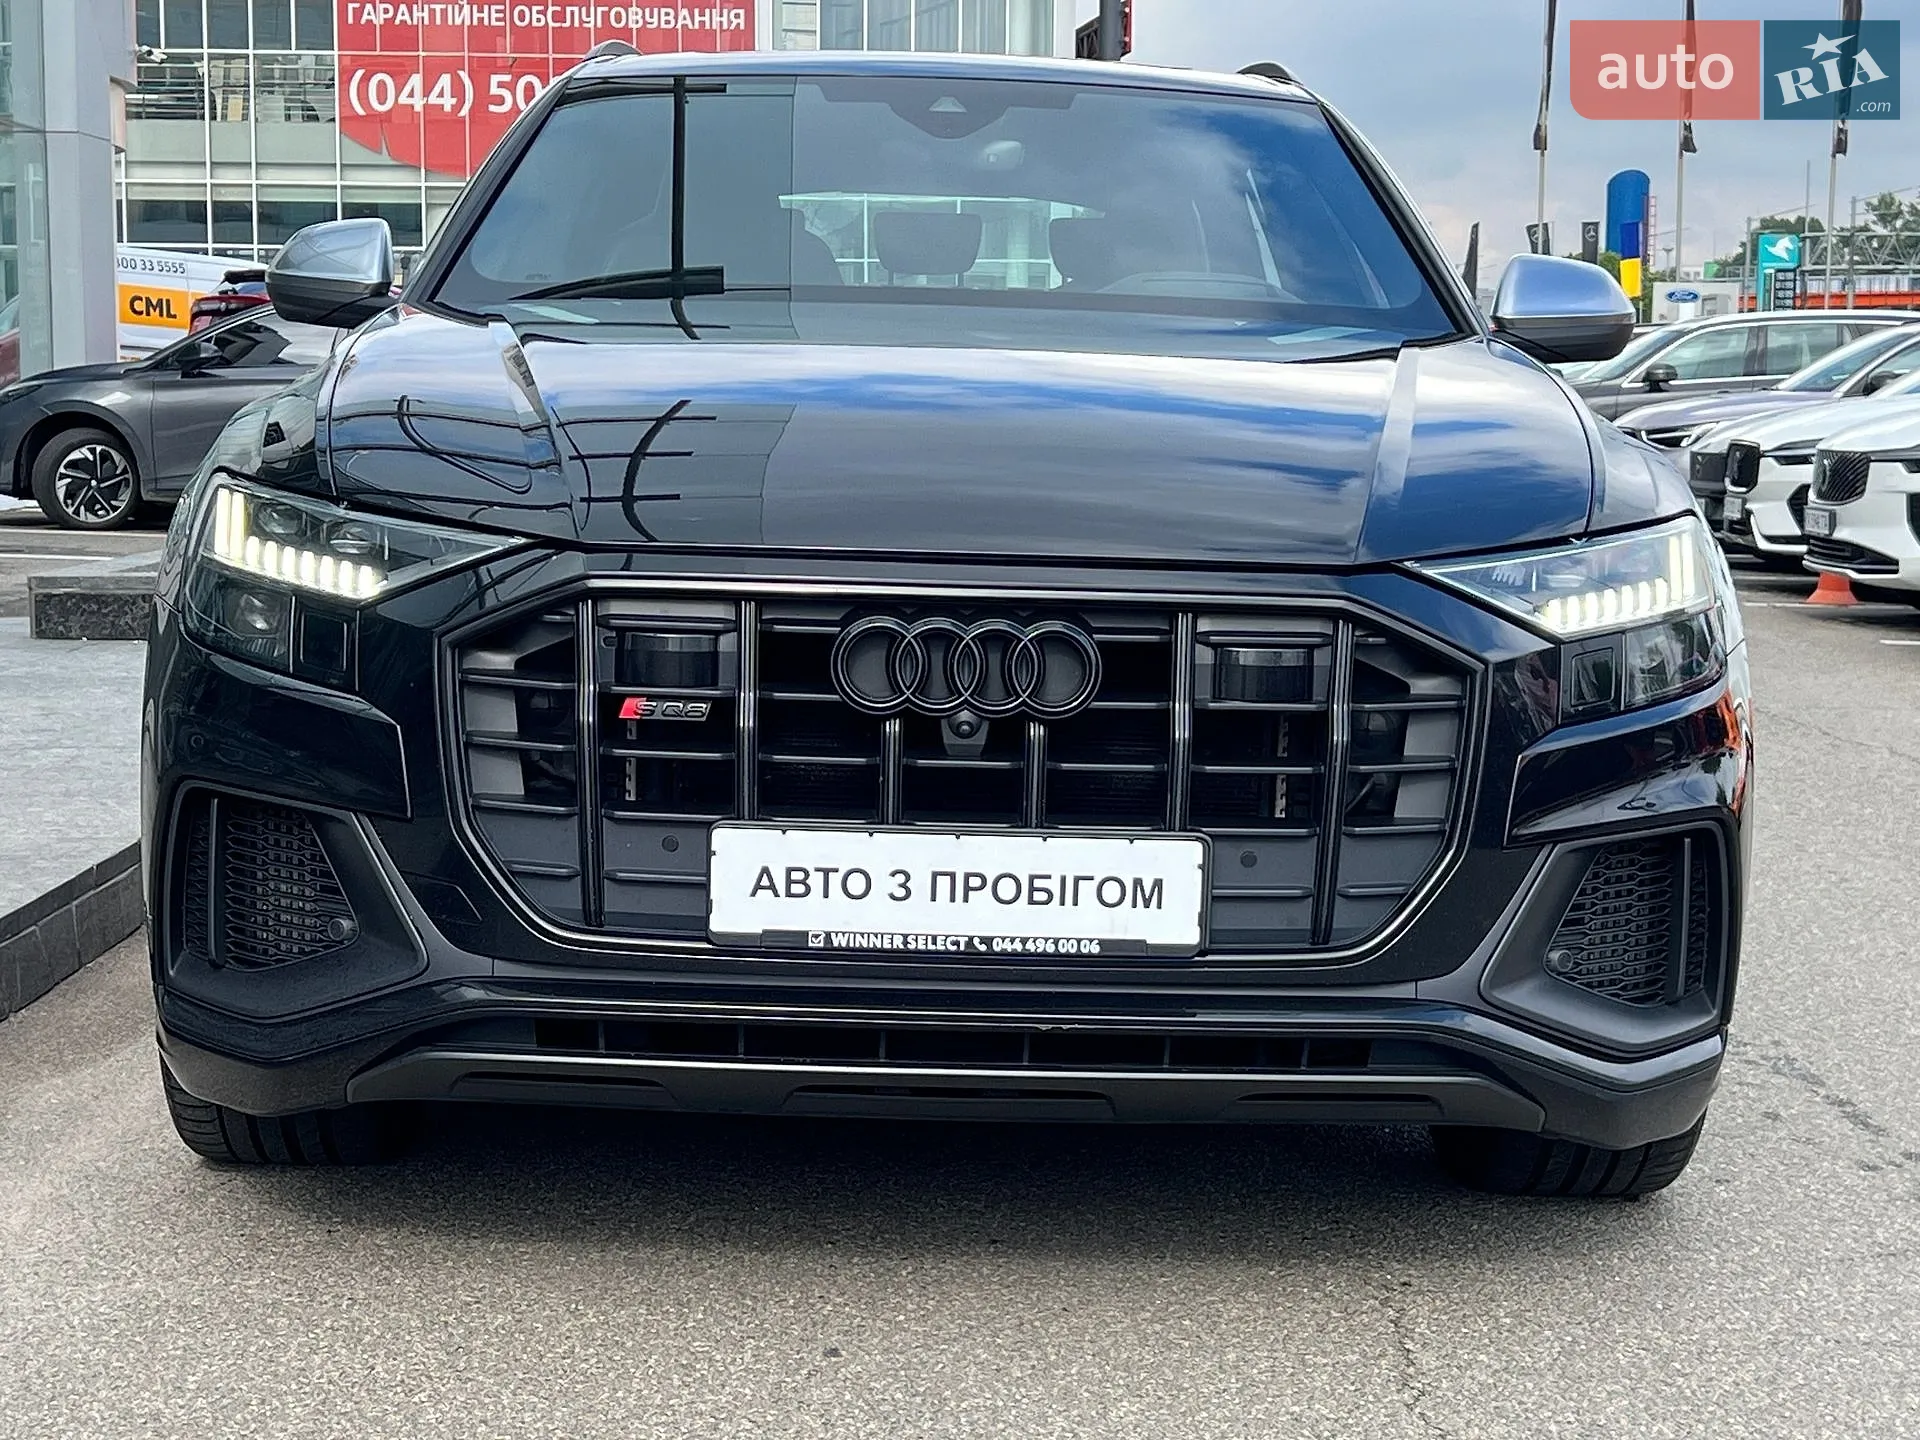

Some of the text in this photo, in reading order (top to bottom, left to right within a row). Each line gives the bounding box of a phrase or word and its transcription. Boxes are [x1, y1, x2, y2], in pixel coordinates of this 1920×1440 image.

[347, 2, 745, 30] ГАРАНТІЙНЕ ОБСЛУГОВУВАННЯ
[349, 69, 562, 117] (044) 50
[140, 259, 154, 272] 33
[157, 260, 186, 274] 5555
[129, 295, 177, 319] CML
[632, 700, 710, 720] SQ8
[749, 865, 872, 901] АВТО
[930, 869, 1164, 910] ПРОБІГОМ
[830, 932, 1101, 955] WINNER SELECT 044 496 00 06
